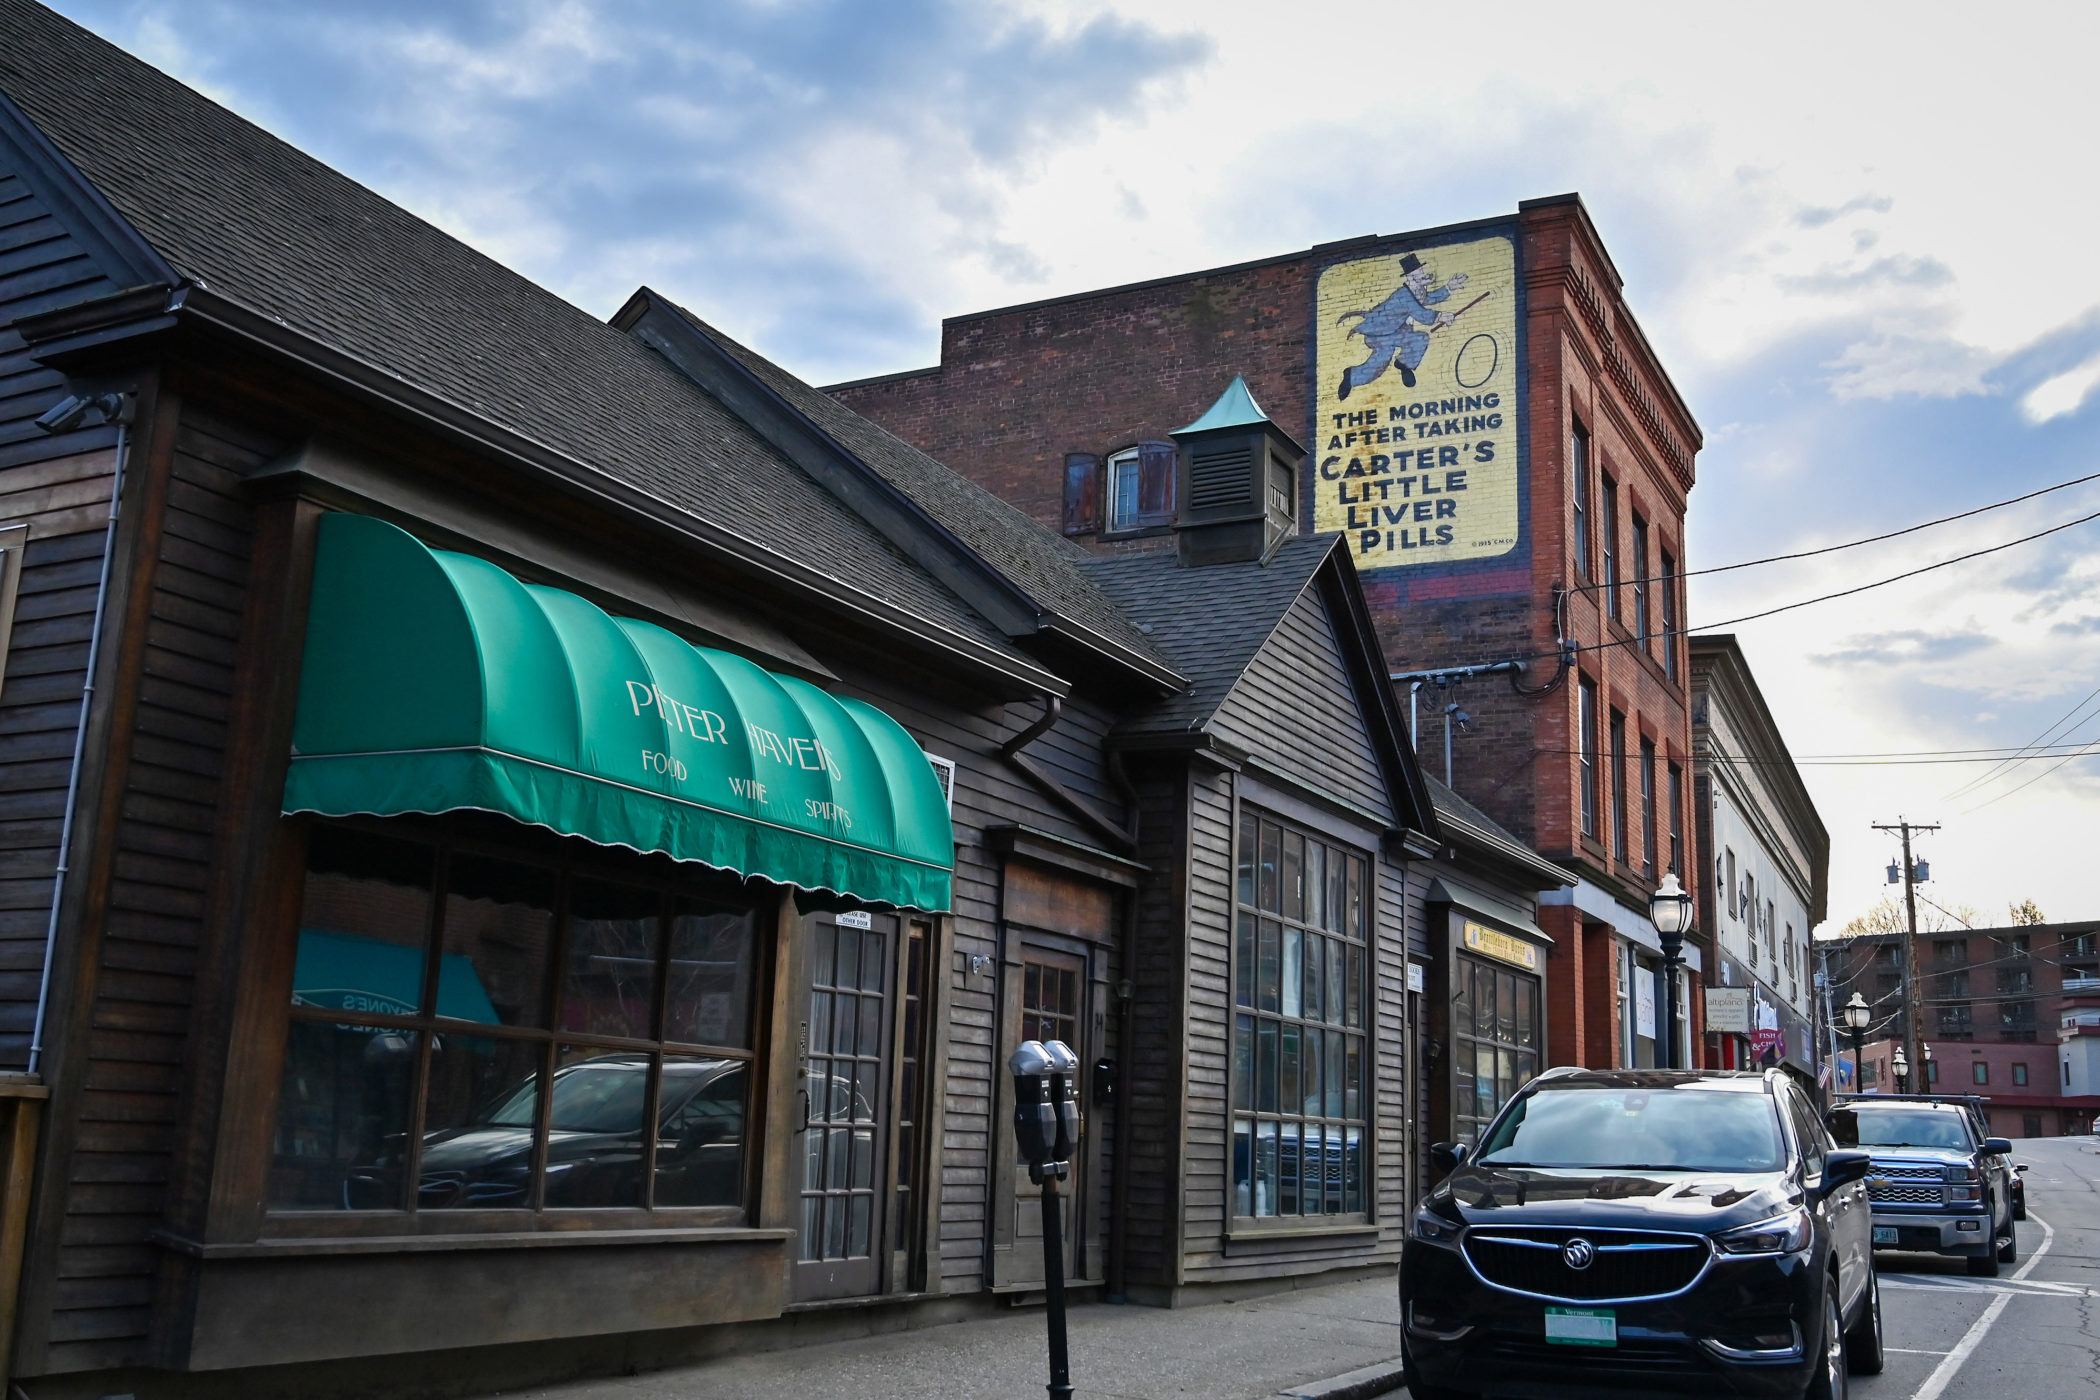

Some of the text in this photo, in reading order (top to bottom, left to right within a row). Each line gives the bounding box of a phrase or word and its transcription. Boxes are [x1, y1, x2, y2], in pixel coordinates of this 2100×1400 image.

[1333, 393, 1500, 429] THE MORNING
[1328, 413, 1503, 450] AFTER TAKING
[1320, 441, 1495, 480] CARTER'S
[1339, 470, 1467, 504] LITTLE
[1347, 498, 1456, 530] LIVER
[1361, 524, 1454, 553] PILLS
[626, 680, 728, 744] PETER
[642, 750, 687, 781] FOOD
[728, 777, 768, 804] WINE
[1565, 1308, 1594, 1317] Vermont
